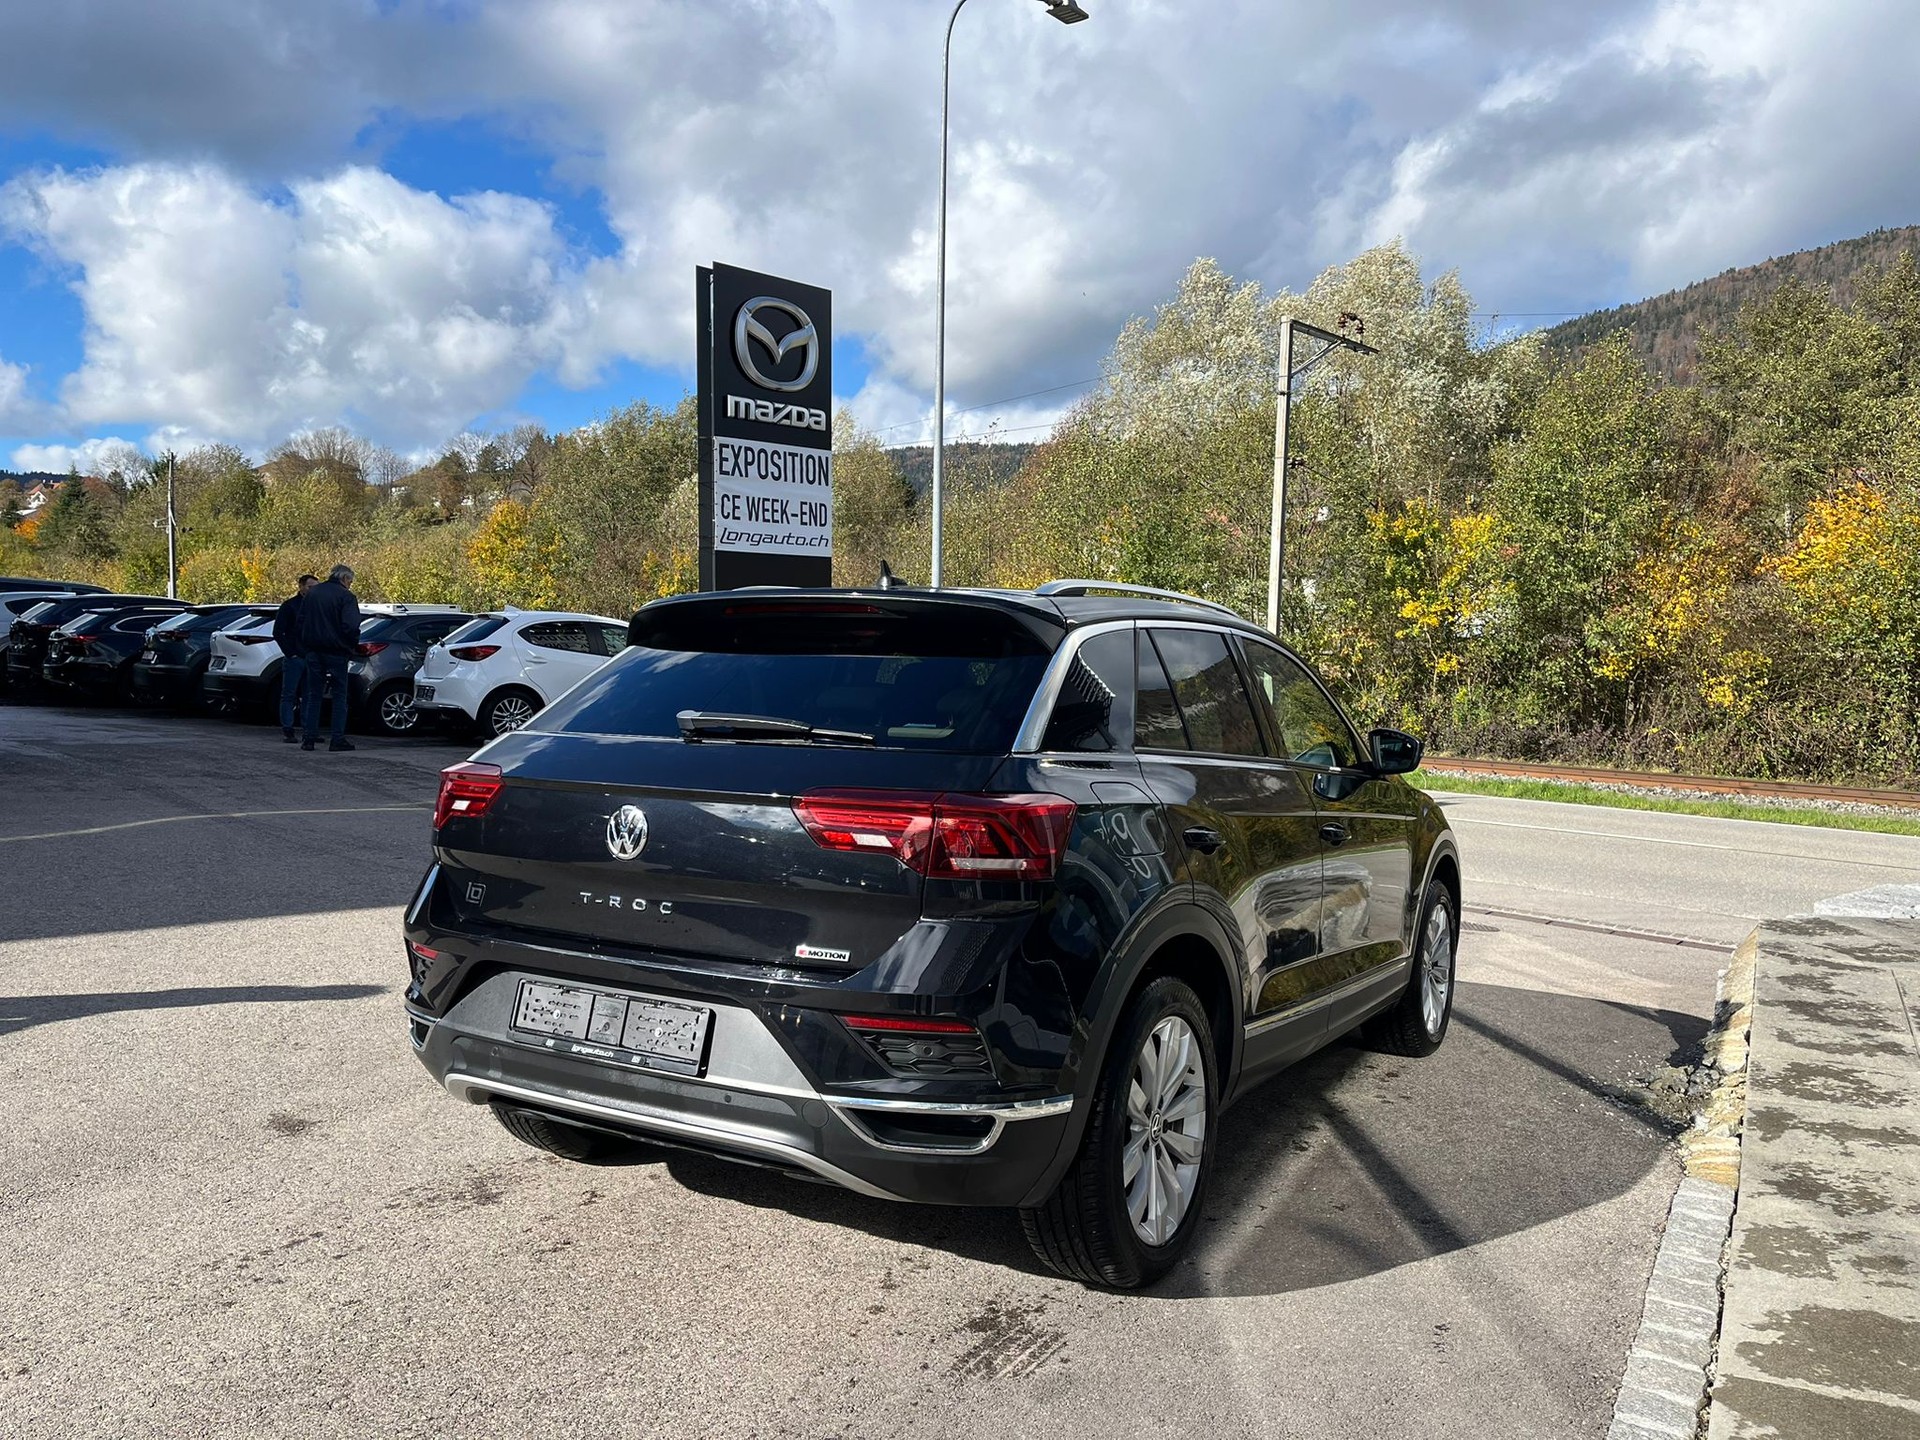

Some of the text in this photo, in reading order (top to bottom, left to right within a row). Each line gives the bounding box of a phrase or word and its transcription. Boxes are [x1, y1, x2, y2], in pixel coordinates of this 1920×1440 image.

[718, 442, 830, 487] EXPOSITION
[720, 493, 828, 528] CE WEEK-END
